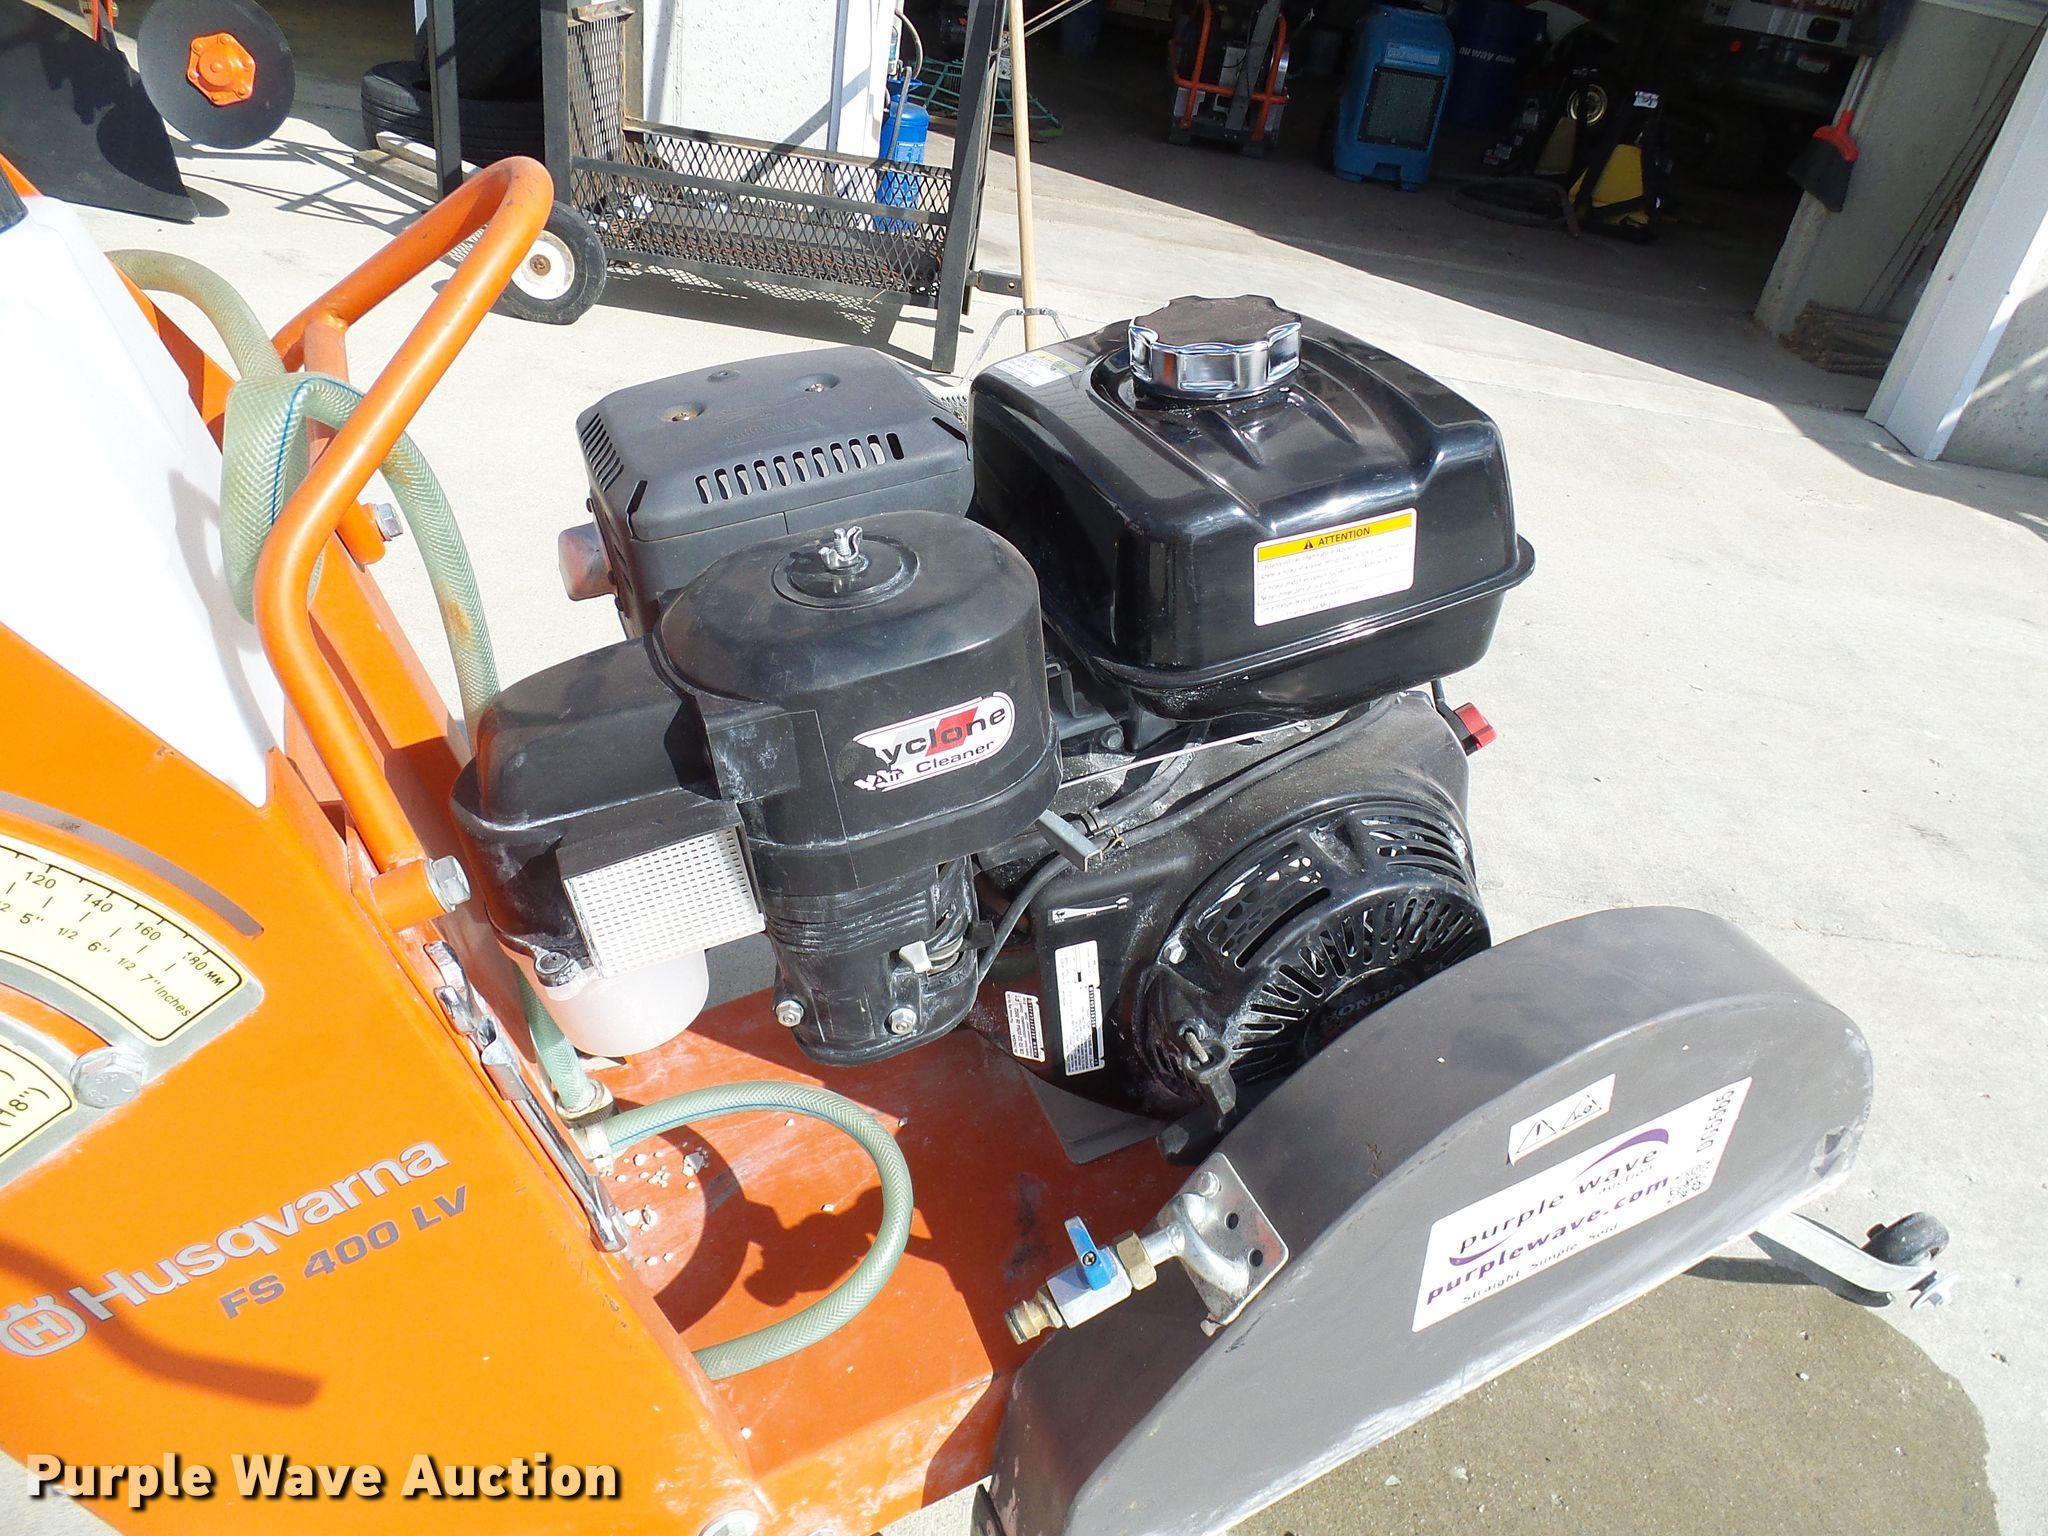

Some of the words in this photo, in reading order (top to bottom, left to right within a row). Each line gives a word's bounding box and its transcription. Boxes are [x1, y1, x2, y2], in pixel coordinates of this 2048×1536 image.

[1318, 527, 1370, 546] ATTENTION
[873, 767, 904, 787] Air
[916, 740, 995, 773] Cleaner
[882, 707, 1006, 766] yclone
[25, 871, 57, 889] 120
[82, 893, 113, 912] 140
[134, 922, 161, 940] 160
[57, 927, 78, 940] 1/2
[117, 957, 136, 971] 1/2
[1324, 983, 1404, 1020] ONDA
[68, 1141, 450, 1321] Husqvarna
[1459, 1194, 1564, 1254] purple
[1578, 1149, 1658, 1195] wave
[219, 1273, 286, 1320] FS
[304, 1219, 401, 1278] 400
[411, 1185, 470, 1230] LV
[1427, 1176, 1669, 1306] purplewave.com
